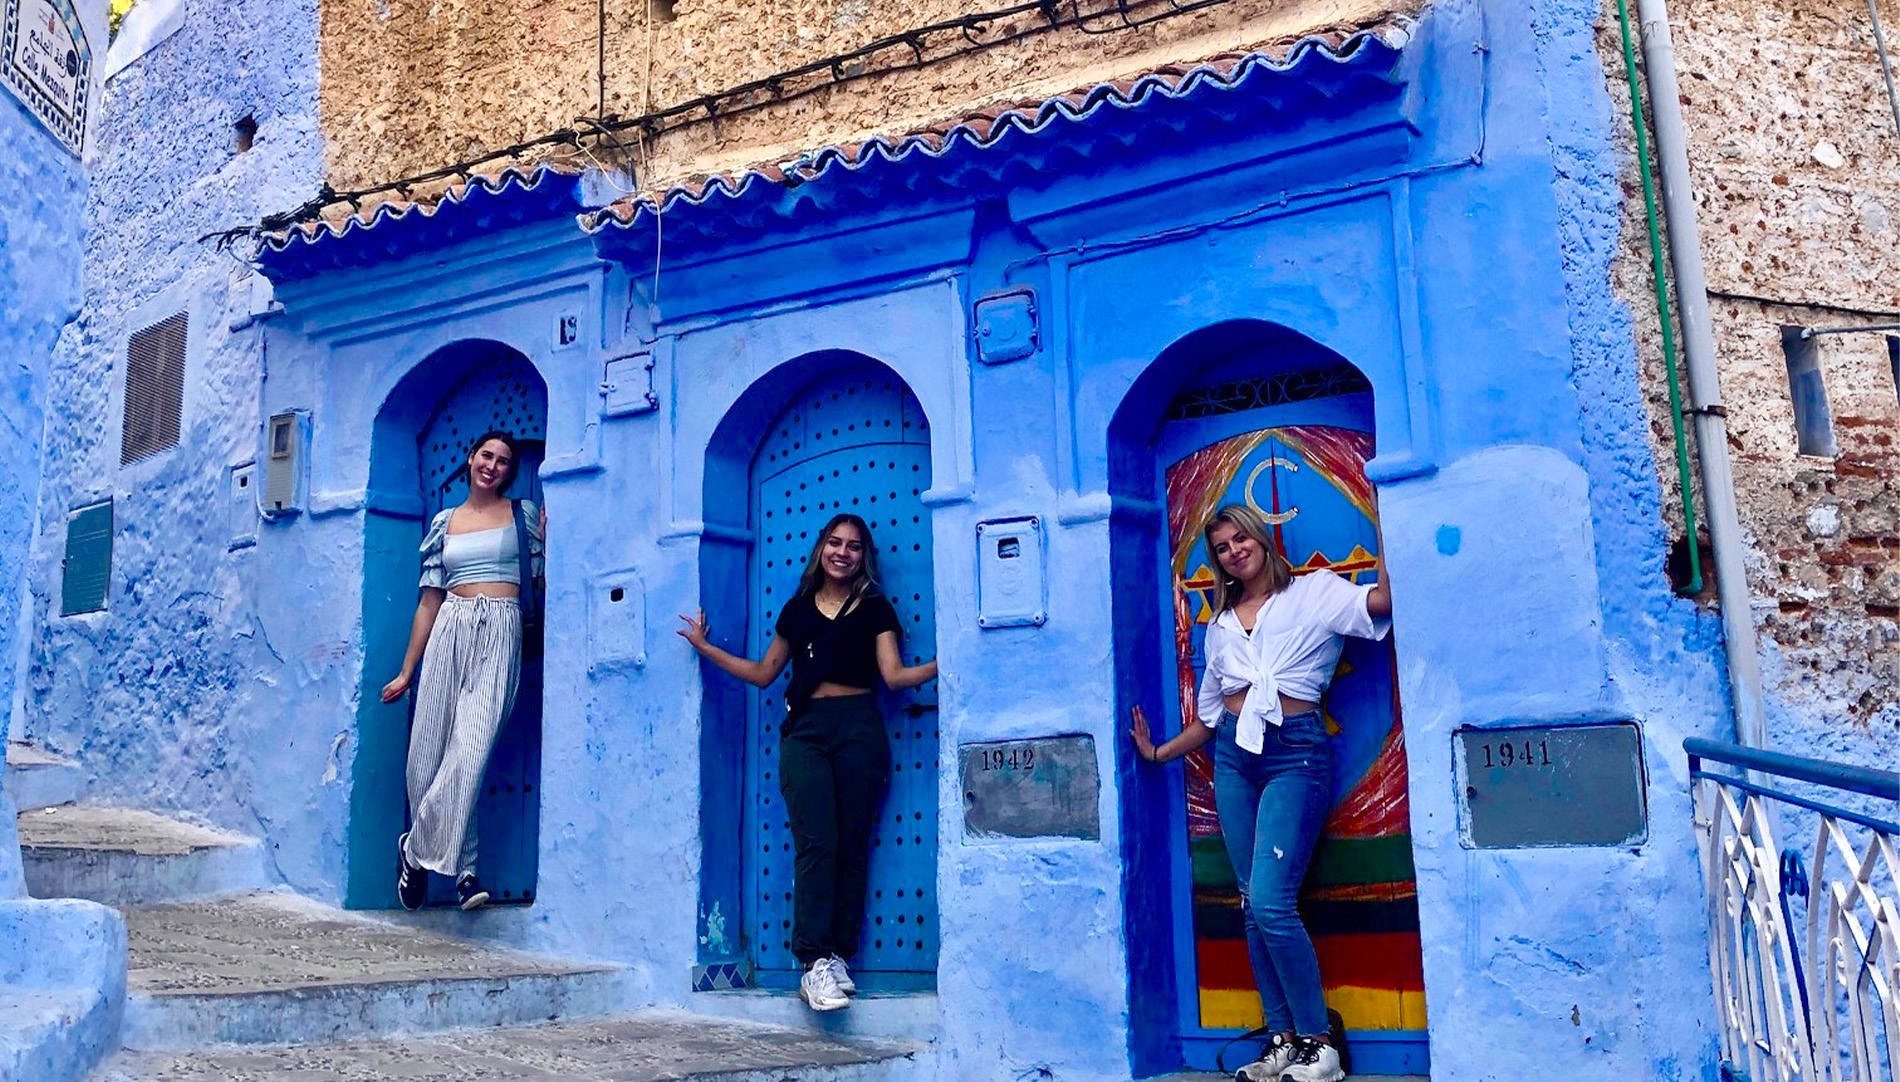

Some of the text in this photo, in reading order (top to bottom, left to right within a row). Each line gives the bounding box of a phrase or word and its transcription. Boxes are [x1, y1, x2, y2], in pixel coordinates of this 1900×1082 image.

[30, 29, 52, 58] الجامع
[22, 46, 69, 106] Calle Mezquita
[982, 749, 1034, 771] 1942
[1483, 741, 1552, 767] 1941
